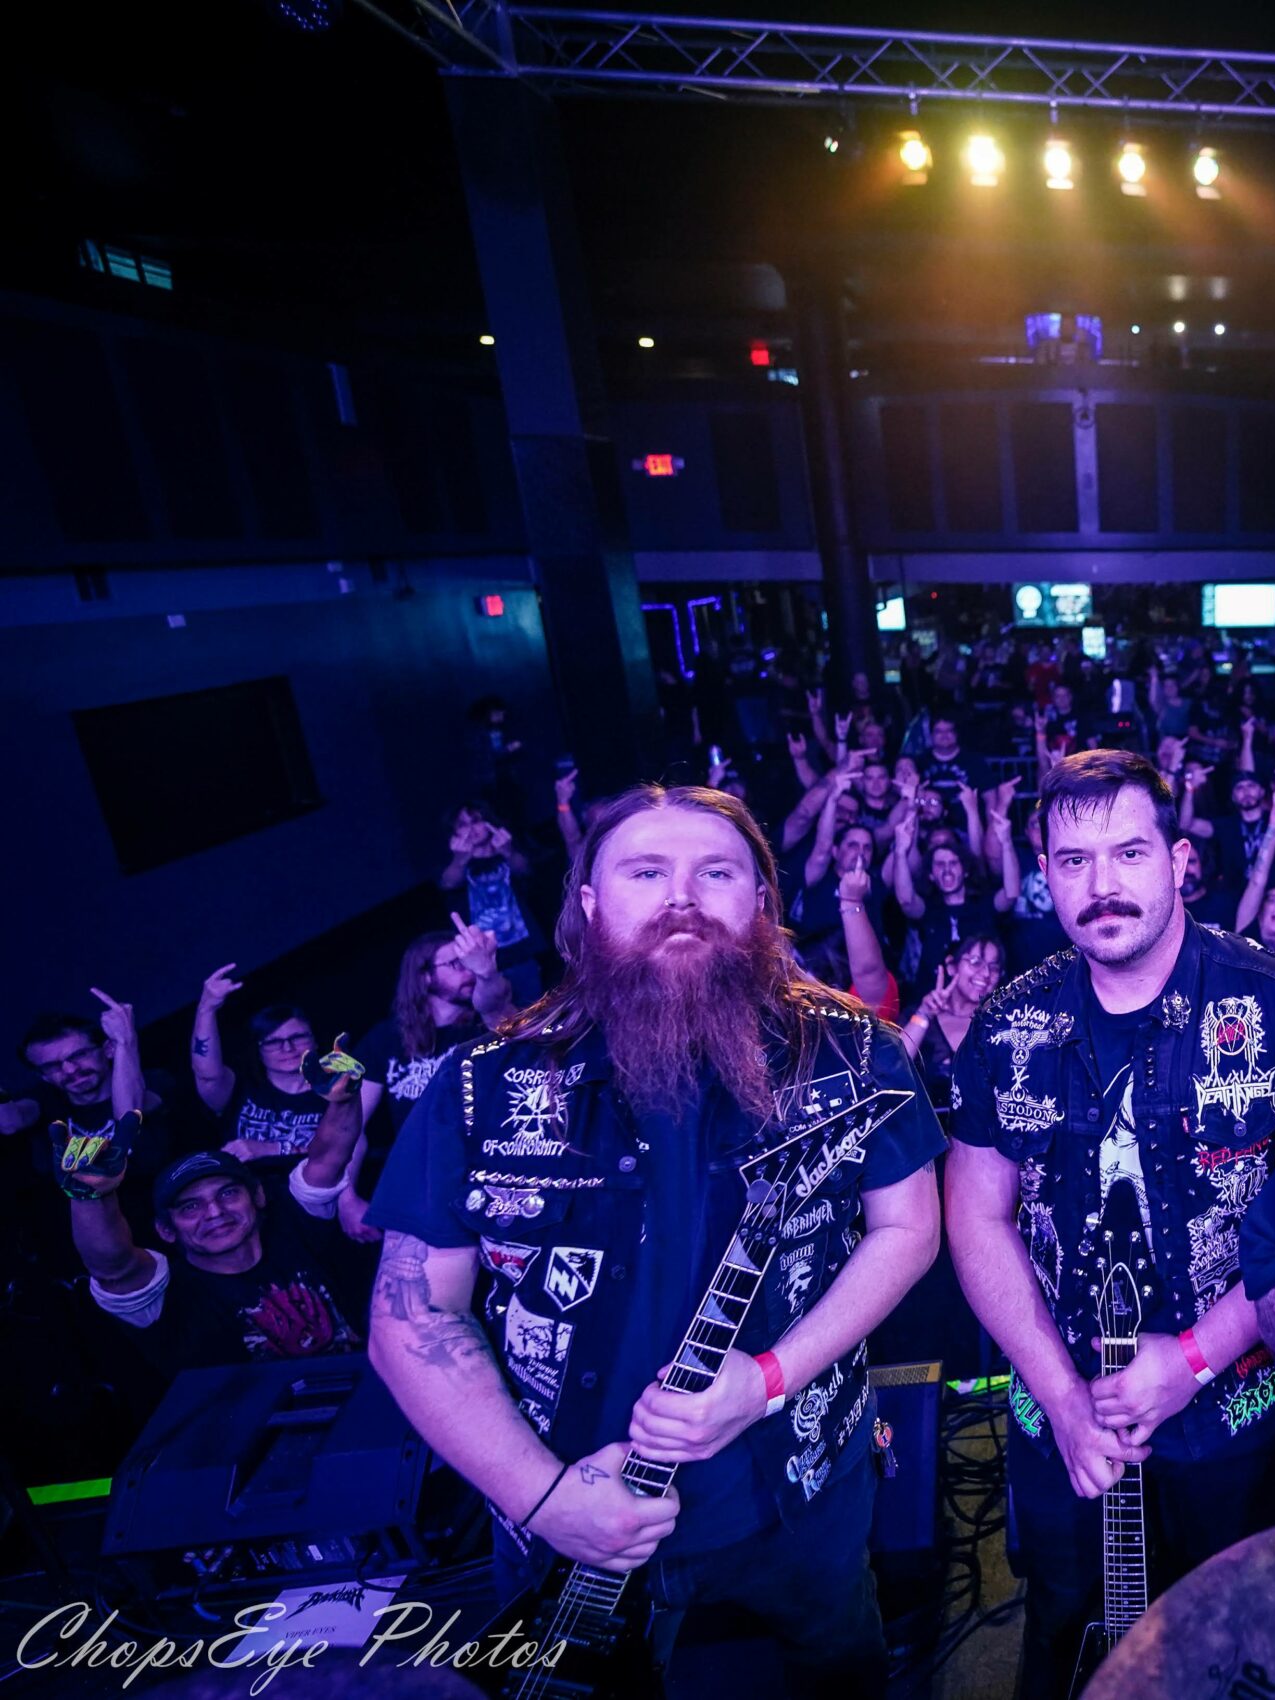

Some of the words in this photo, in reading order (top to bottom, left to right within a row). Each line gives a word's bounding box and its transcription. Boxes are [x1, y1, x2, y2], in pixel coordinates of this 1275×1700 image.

[502, 1066, 566, 1087] CORROSI
[1001, 1102, 1053, 1123] STODON
[483, 1139, 500, 1156] OF
[498, 1140, 570, 1157] CONFORMITY
[795, 1117, 872, 1198] Jackson
[1011, 1384, 1043, 1438] KILL
[284, 1628, 310, 1639] VIPER
